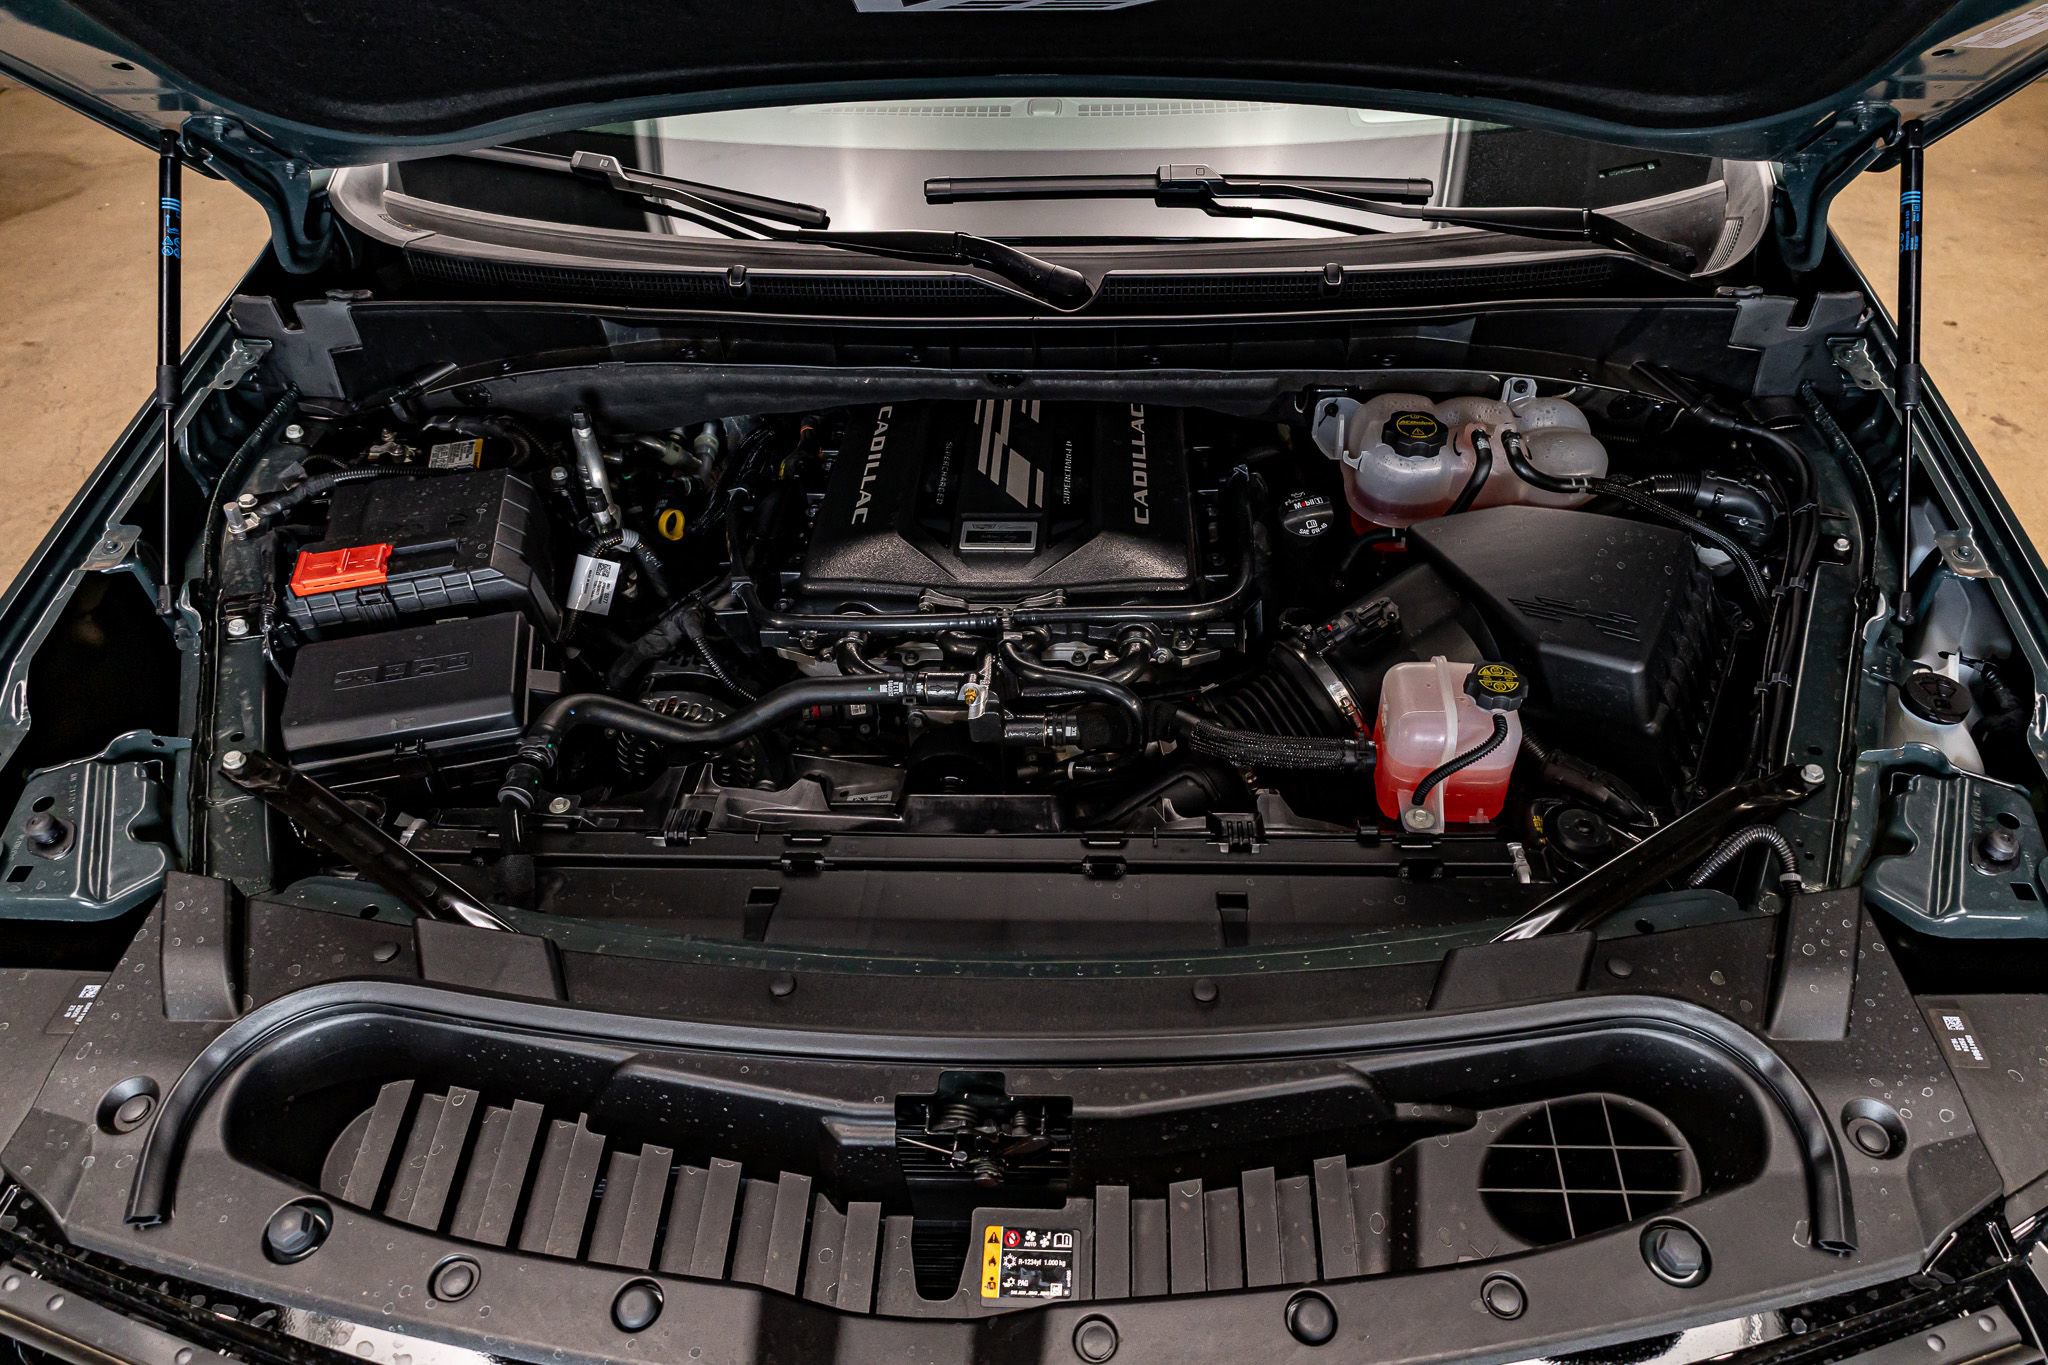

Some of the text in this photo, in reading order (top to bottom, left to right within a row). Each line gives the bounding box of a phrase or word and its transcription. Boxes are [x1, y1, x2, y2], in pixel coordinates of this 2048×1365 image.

[852, 405, 893, 525] CADILLAC
[1130, 403, 1150, 525] CADILLAC
[1293, 499, 1315, 509] Mobil
[1018, 1259, 1041, 1267] R-1234yf
